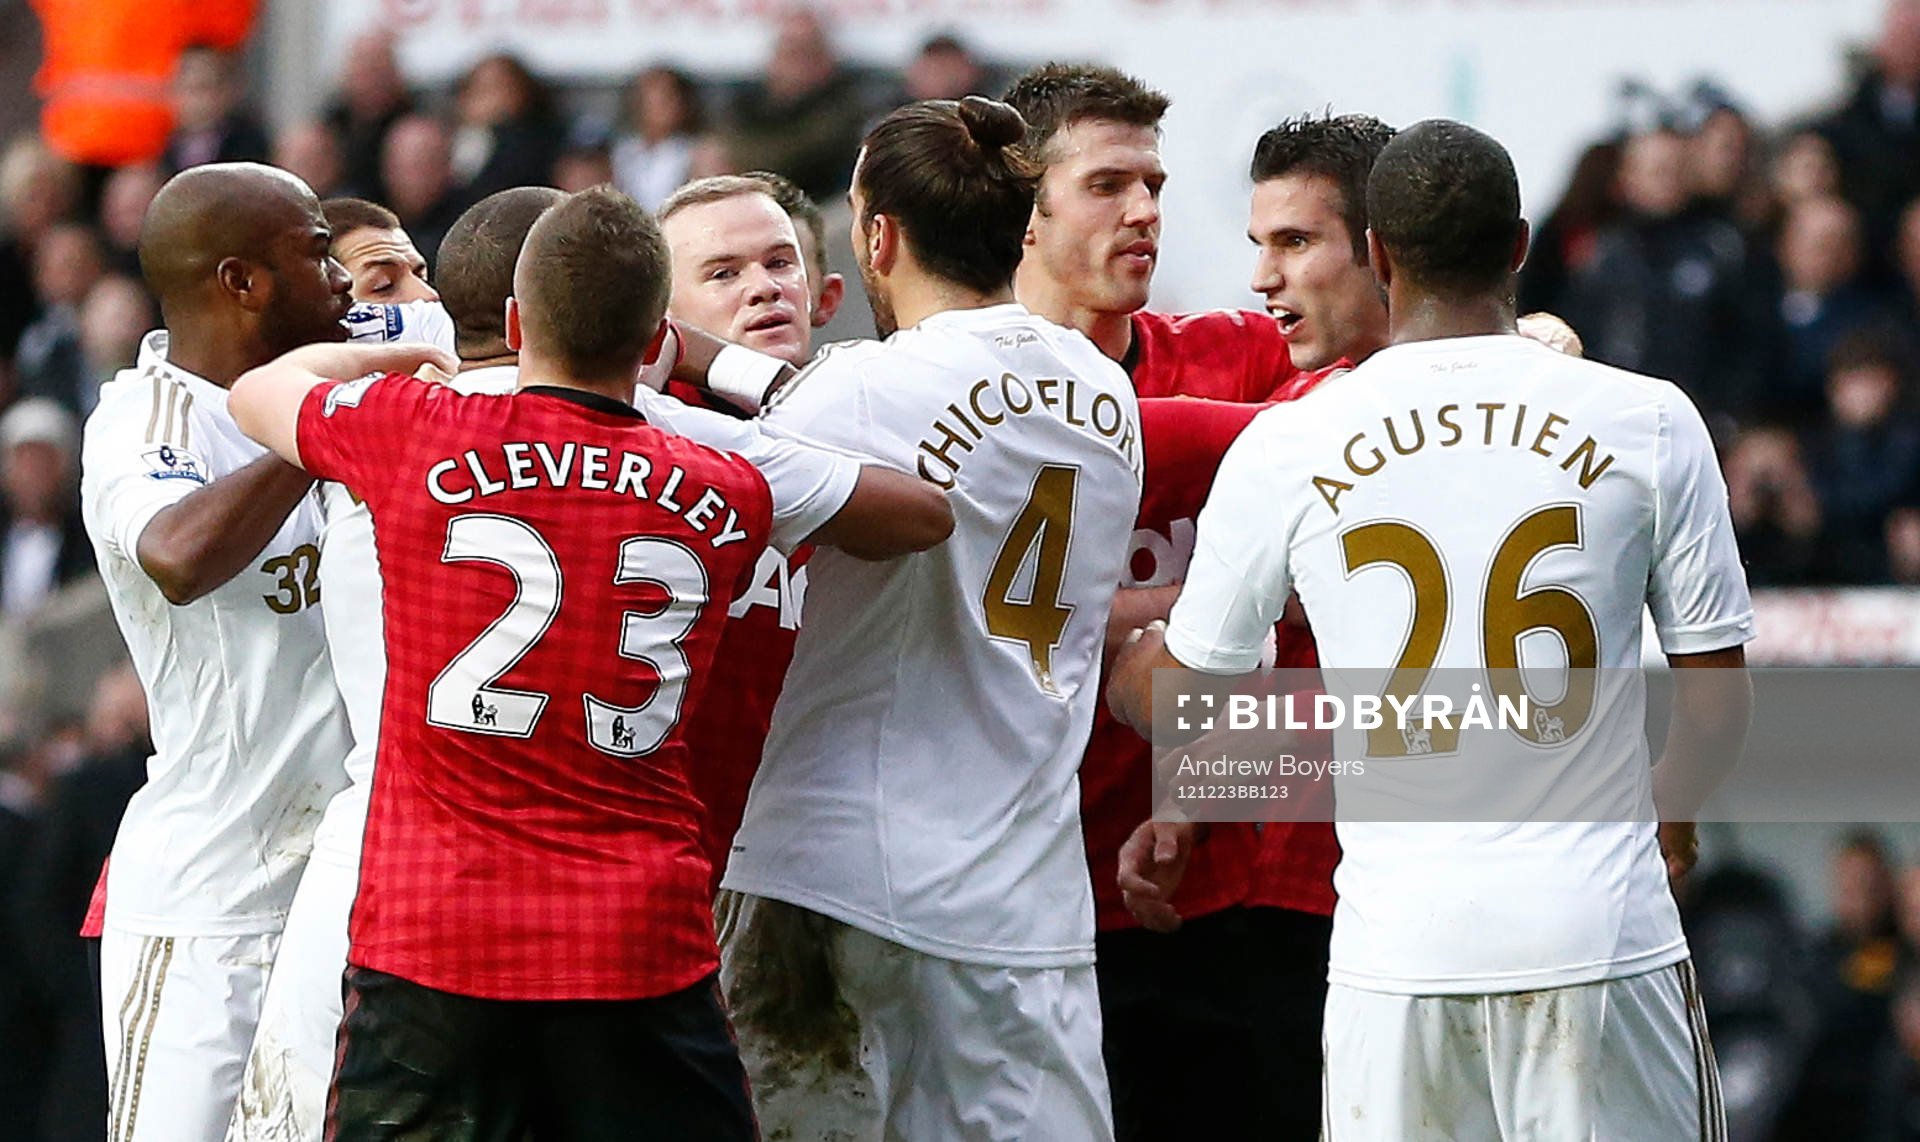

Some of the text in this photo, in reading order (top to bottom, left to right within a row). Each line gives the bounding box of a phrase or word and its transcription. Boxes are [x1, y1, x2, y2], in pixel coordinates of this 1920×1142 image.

[426, 442, 748, 548] CLEVERLEY
[1311, 402, 1616, 515] AGUSTIEN
[260, 543, 321, 614] 32
[426, 513, 710, 759] 23
[981, 461, 1082, 699] 4
[1337, 501, 1602, 760] 26
